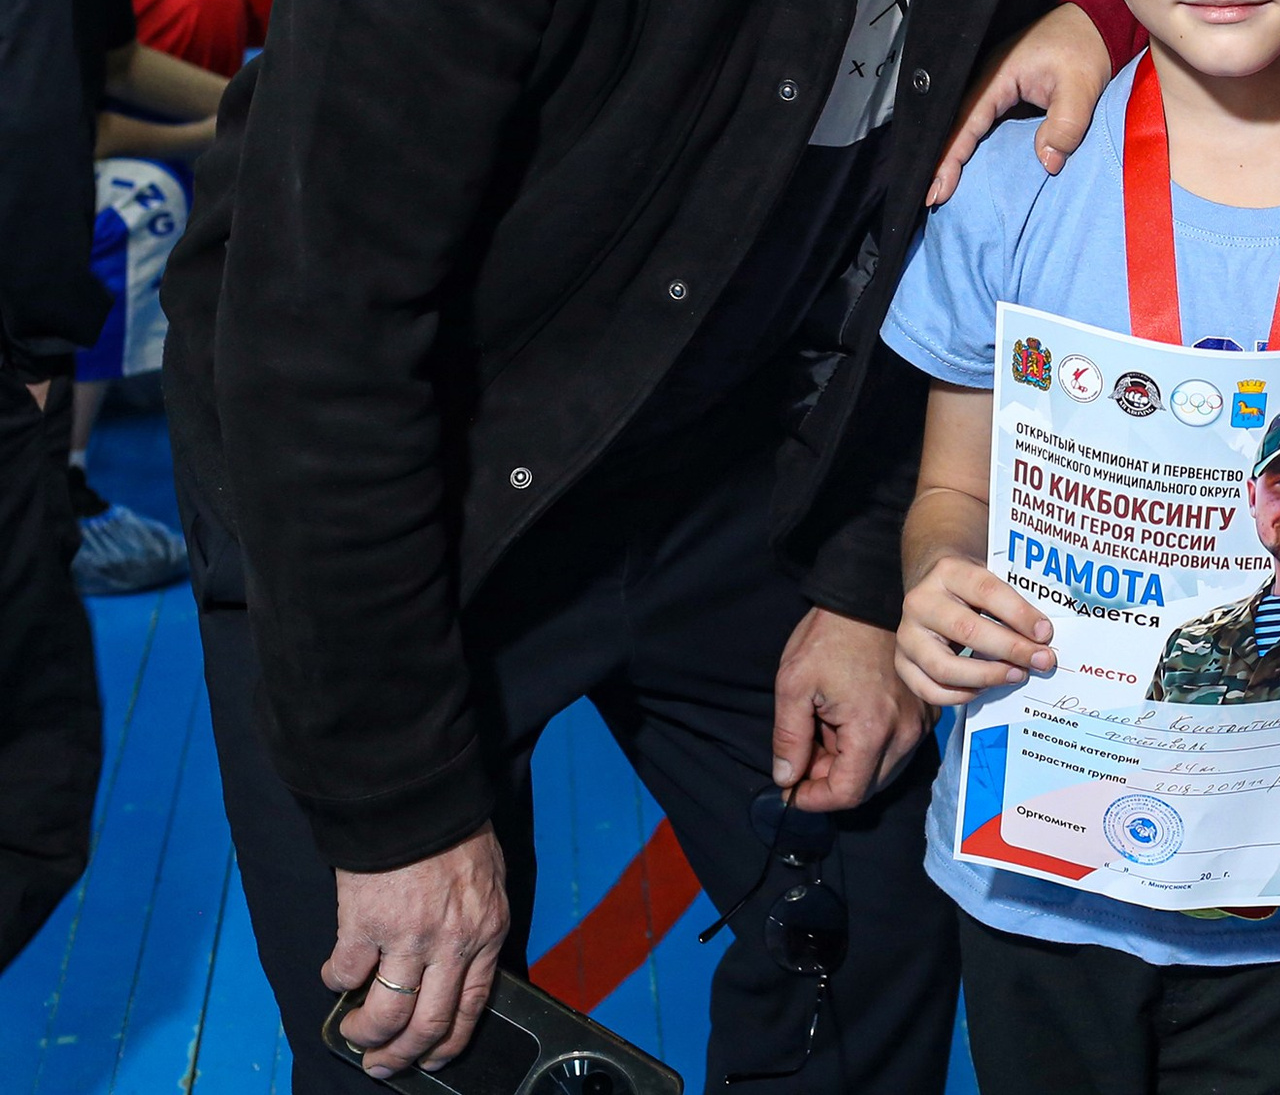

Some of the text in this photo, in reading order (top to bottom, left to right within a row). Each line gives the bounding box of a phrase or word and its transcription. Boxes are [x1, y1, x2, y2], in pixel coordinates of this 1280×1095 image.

[1015, 439, 1241, 498] МИНУСИНСКОГО МУНИЦИПАЛЬНОГО ОКРУГА
[1016, 422, 1243, 482] ОТКРЫТЫЙ ЧЕМПИОНАТ И ПЕРВЕНСТВО
[1012, 487, 1216, 552] ПАМЯТИ ГЕРОЯ РОССИИ
[1014, 458, 1236, 531] ПО КИКБОКСИНГУ
[1011, 508, 1272, 570] ВЛАДИМИРА АЛЕКСАНДРОВИЧА ЧЕПА
[1008, 529, 1165, 607] ГРАМОТА
[1007, 572, 1160, 628] награждается
[1079, 664, 1137, 684] место
[1024, 706, 1079, 729] в разделе
[1021, 749, 1127, 785] возрастная группа
[1031, 730, 1078, 750] весовой
[1080, 745, 1140, 765] категории
[1016, 805, 1087, 833] Оргкомитет
[1148, 881, 1192, 890] Минусинск
